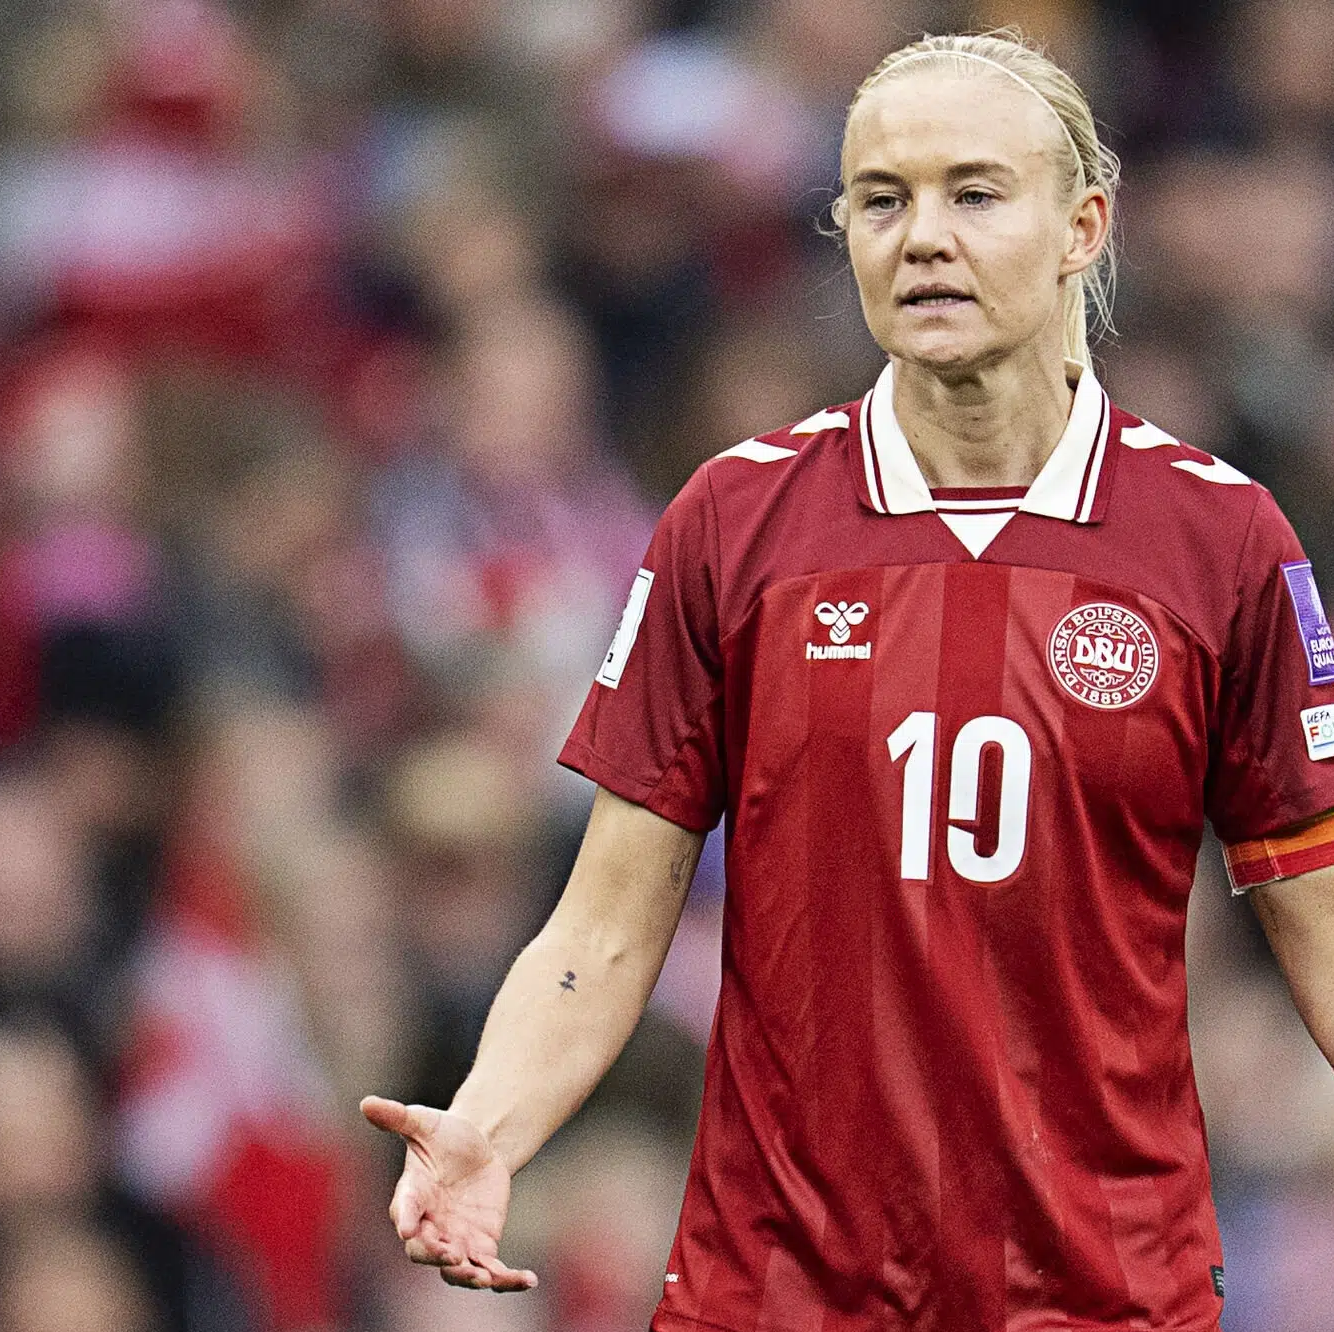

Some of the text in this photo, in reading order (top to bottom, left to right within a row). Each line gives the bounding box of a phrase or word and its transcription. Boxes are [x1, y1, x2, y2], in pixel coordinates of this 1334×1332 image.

[805, 641, 872, 660] hummel
[1054, 624, 1078, 687] DANSK
[1072, 635, 1136, 672] DBU
[1080, 686, 1122, 705] 1889
[1307, 710, 1331, 724] UEFA
[887, 711, 1032, 883] 10
